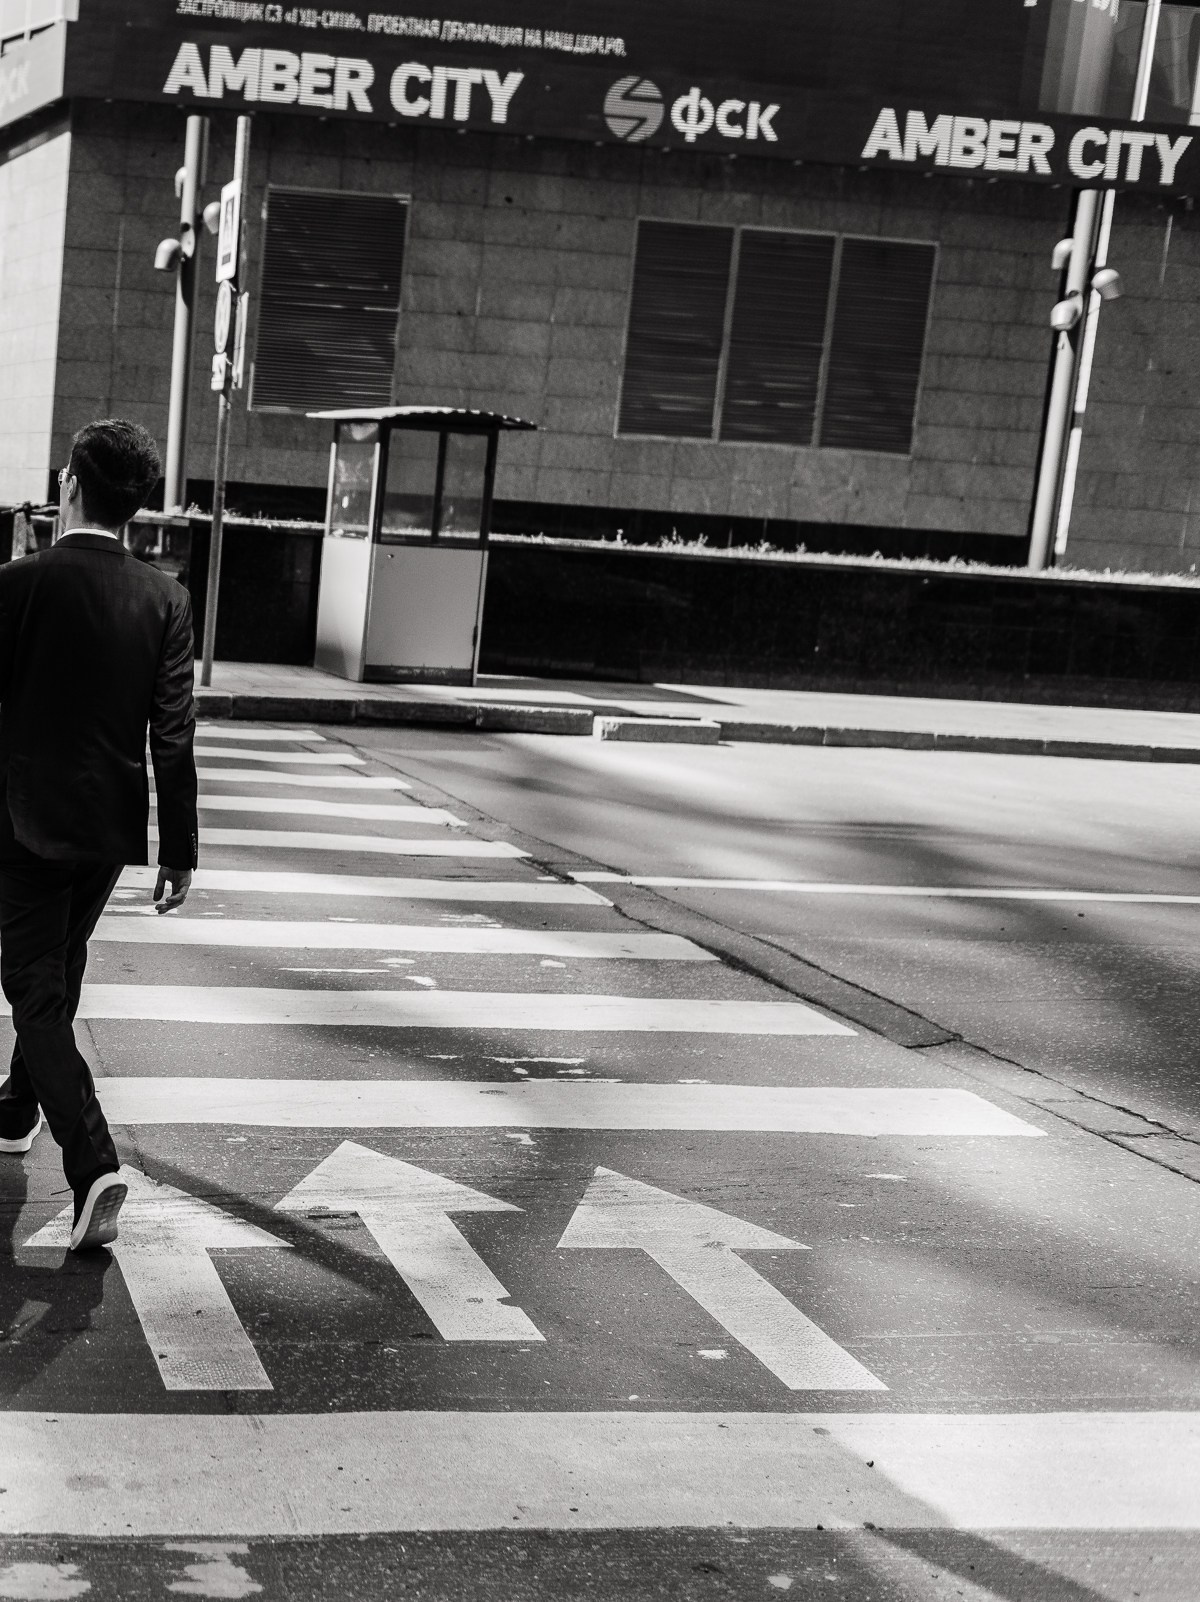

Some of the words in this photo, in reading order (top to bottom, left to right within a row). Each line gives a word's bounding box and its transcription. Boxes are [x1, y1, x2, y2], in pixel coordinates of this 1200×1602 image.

[367, 13, 440, 38] ПРОЕКТНАЯ
[524, 28, 542, 48] НА
[162, 42, 375, 113] AMBER
[390, 61, 525, 124] CITY
[861, 107, 1055, 175] AMBER
[1068, 126, 1193, 186] CITY
